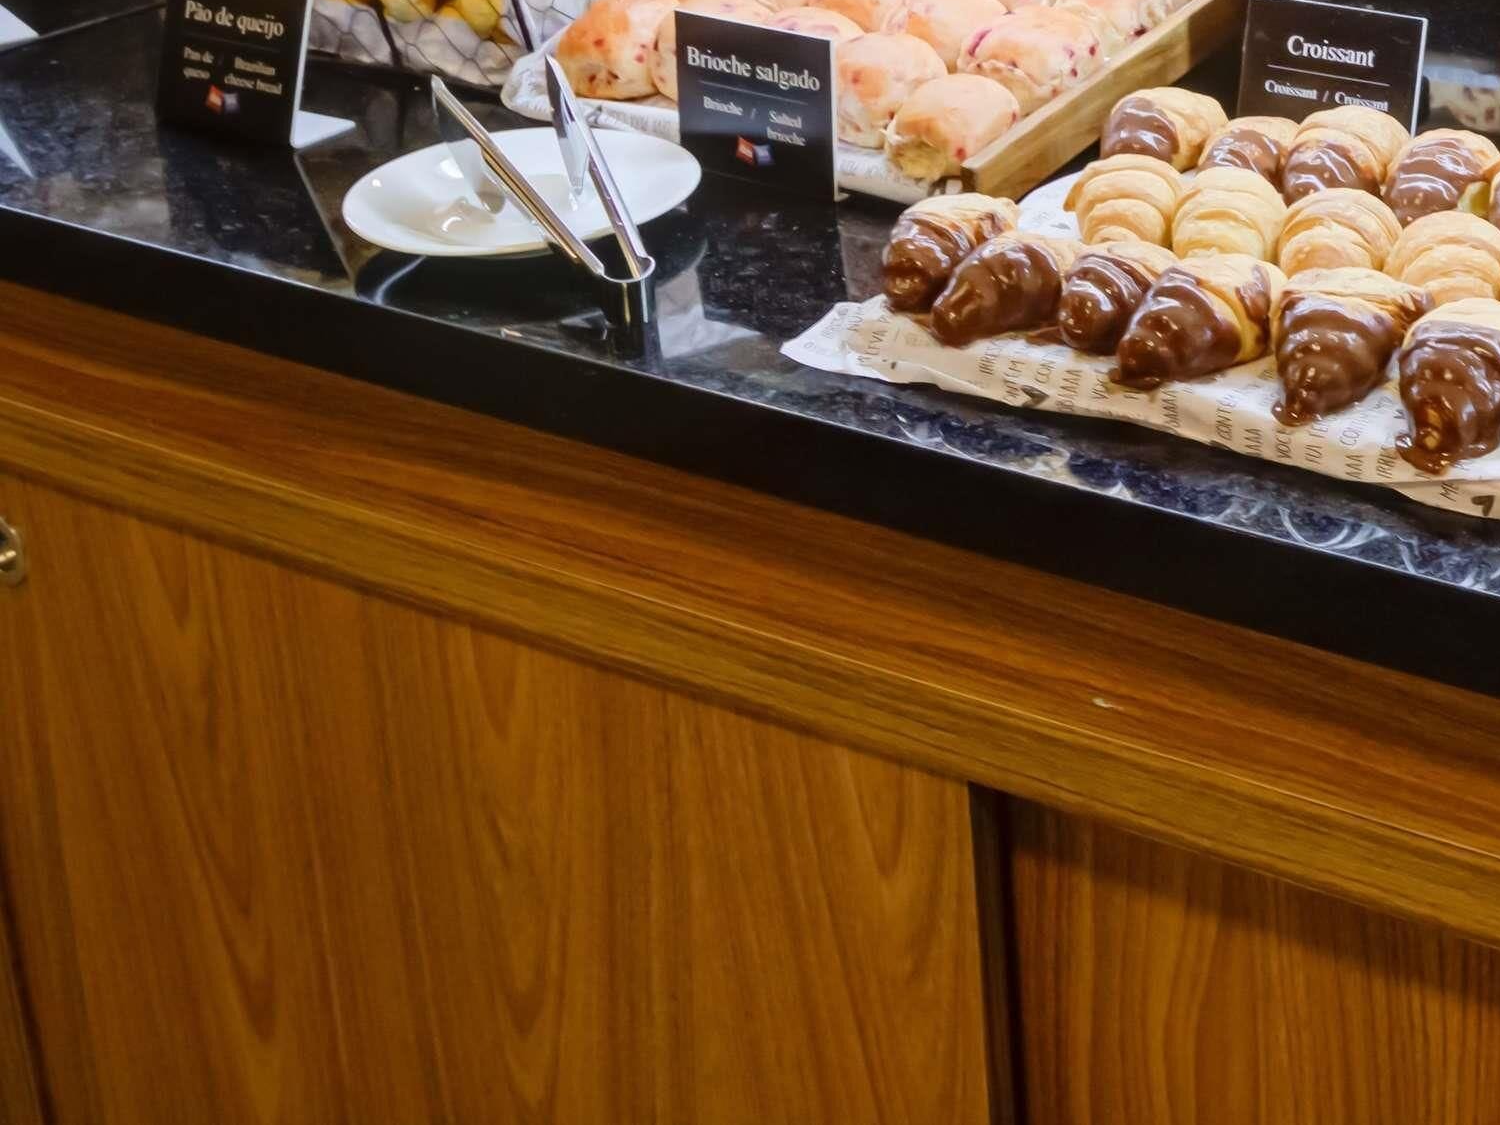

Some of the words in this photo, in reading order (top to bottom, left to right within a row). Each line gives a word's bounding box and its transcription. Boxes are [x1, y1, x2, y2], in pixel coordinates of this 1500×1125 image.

[185, 0, 212, 23] Pão
[216, 7, 233, 27] de
[236, 14, 284, 40] queijo
[1286, 35, 1376, 67] Croissant
[687, 45, 751, 77] Brioche
[755, 63, 820, 91] salgado
[1264, 79, 1318, 100] Croissant
[703, 96, 743, 116] Brioche
